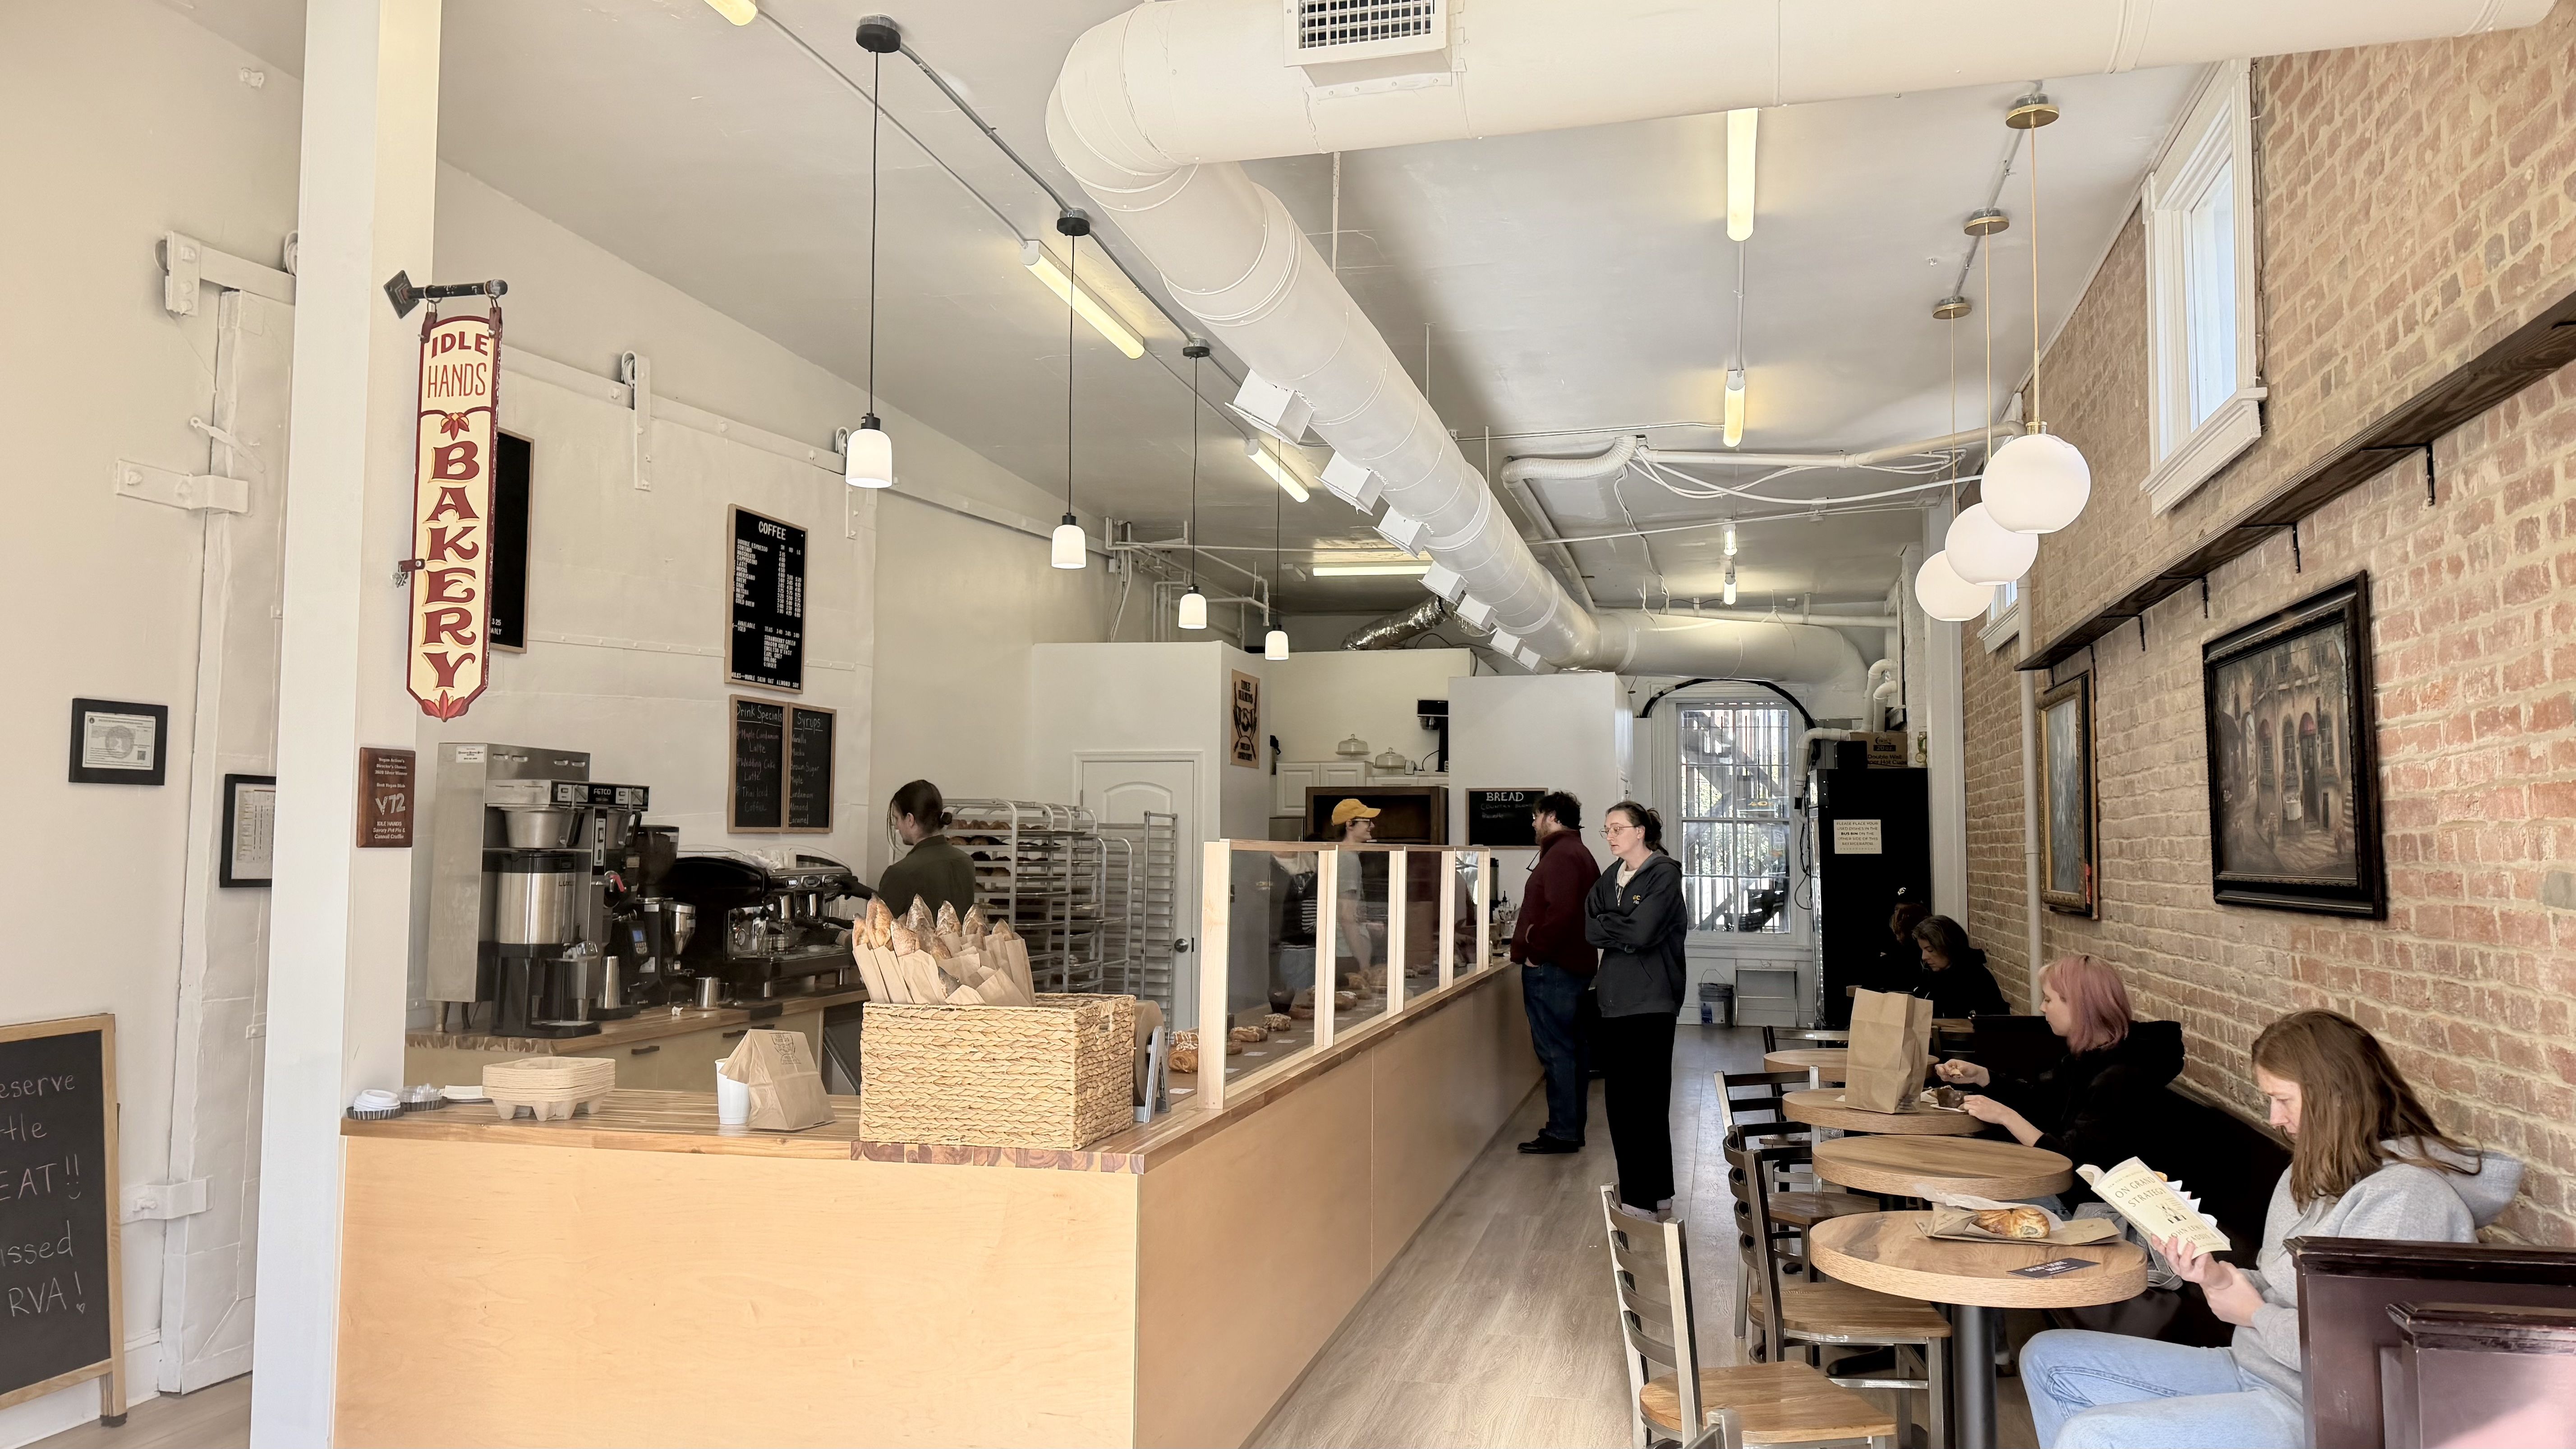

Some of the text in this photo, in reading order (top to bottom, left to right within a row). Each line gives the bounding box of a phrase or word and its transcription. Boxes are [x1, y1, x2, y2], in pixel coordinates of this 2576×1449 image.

[431, 331, 489, 359] IDLE
[428, 362, 487, 398] HANDS
[759, 521, 786, 540] COFFEE
[421, 440, 480, 690] BAKERY
[737, 704, 782, 724] Drink Specials
[797, 712, 821, 735] Syrups
[1486, 792, 1524, 802] BREAD
[0, 1112, 47, 1142] tle
[2115, 1176, 2156, 1198] ON GRAND
[2128, 1187, 2167, 1207] STRATEGY
